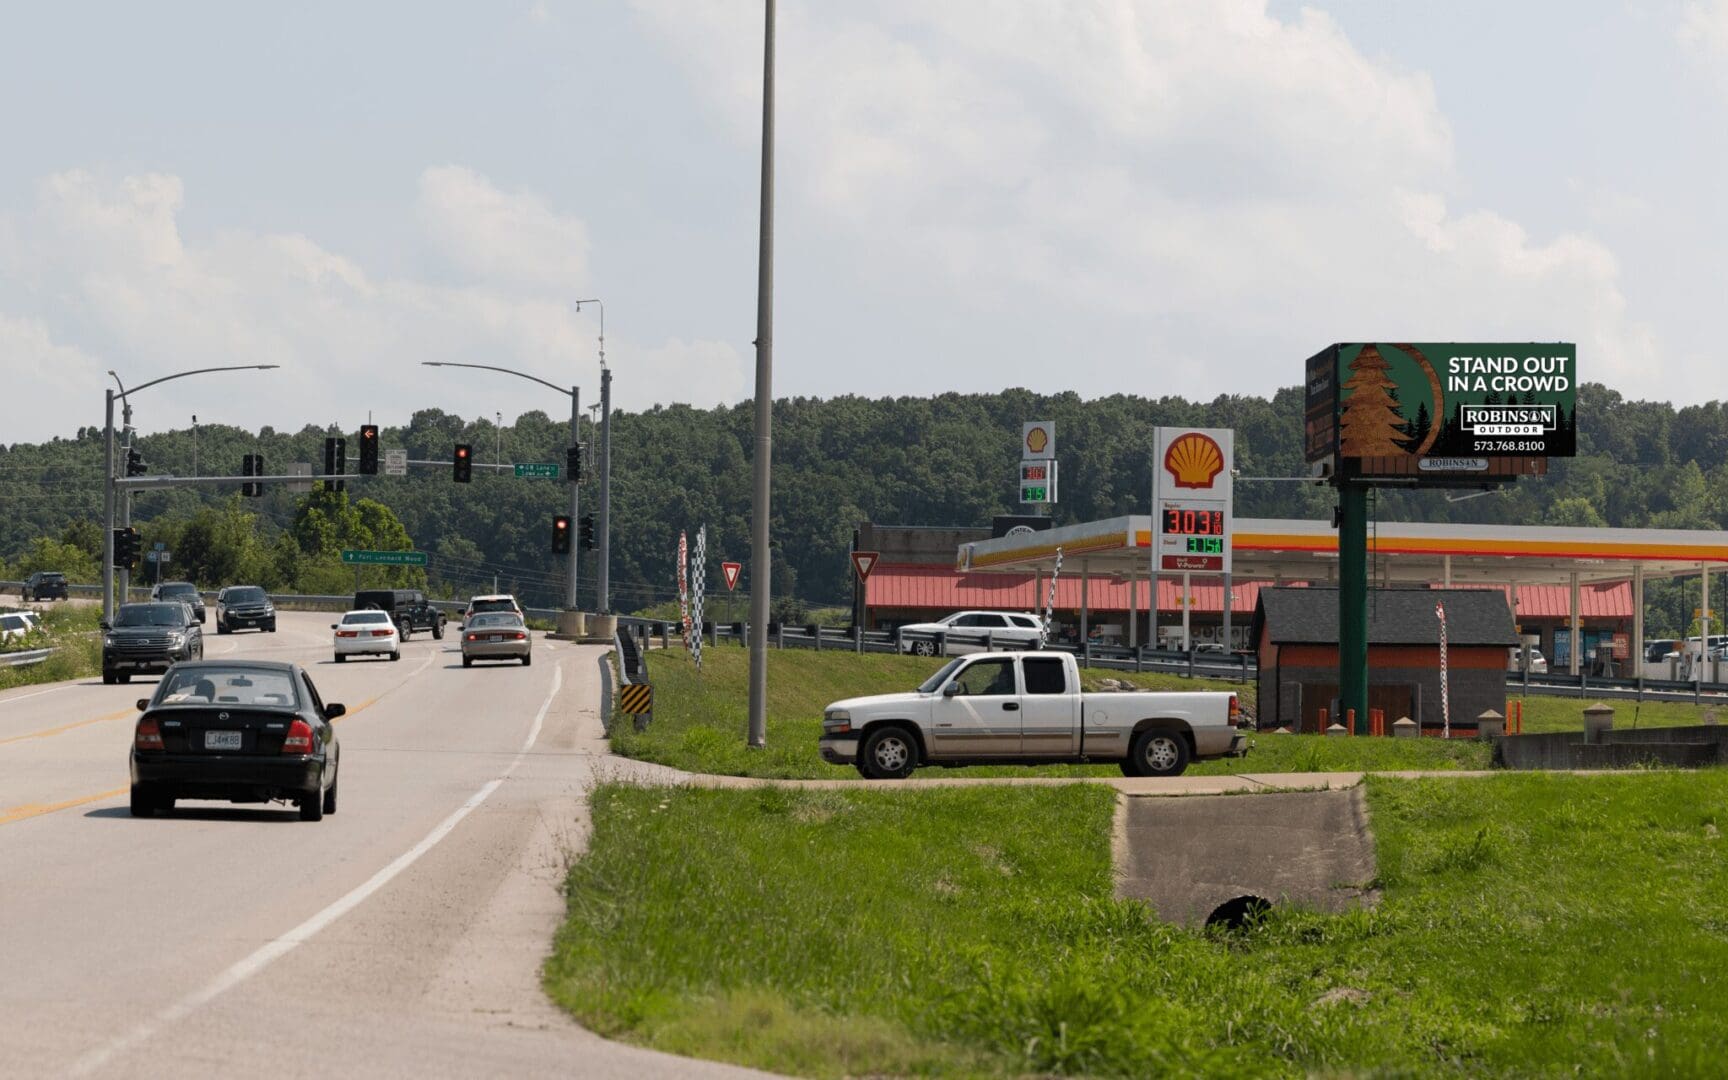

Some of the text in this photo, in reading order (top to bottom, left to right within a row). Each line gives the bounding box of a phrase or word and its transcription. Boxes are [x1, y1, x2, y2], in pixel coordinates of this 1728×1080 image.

[1448, 357, 1569, 374] STAND OUT
[1448, 376, 1569, 392] IN A CROWD
[1474, 441, 1545, 451] 573.768.8100
